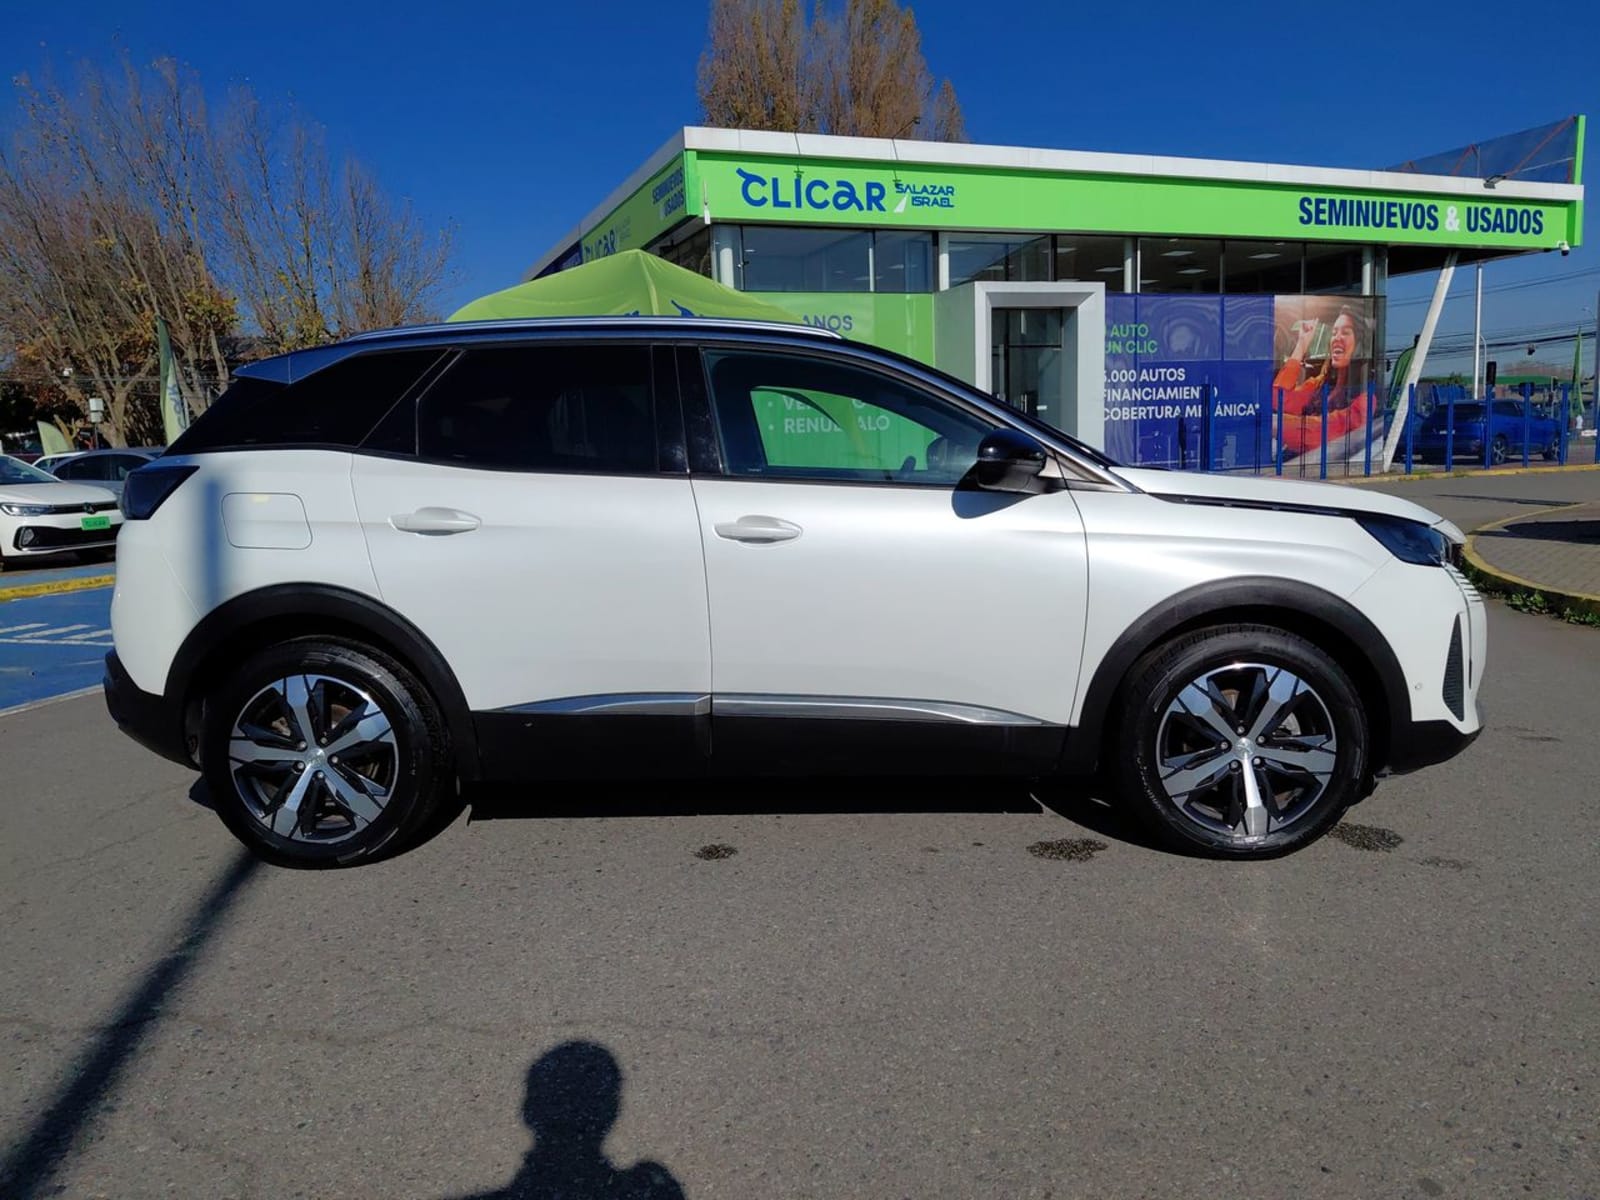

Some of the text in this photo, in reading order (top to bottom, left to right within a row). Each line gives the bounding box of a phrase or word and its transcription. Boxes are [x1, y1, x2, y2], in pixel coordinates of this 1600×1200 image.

[895, 183, 955, 196] SALAZAR
[911, 196, 955, 208] ISRAEL
[1299, 196, 1544, 235] SEMINUEVOS & USADOS
[1110, 324, 1149, 338] AUTO
[1125, 340, 1158, 354] CLIC
[1139, 368, 1186, 382] AUTOS
